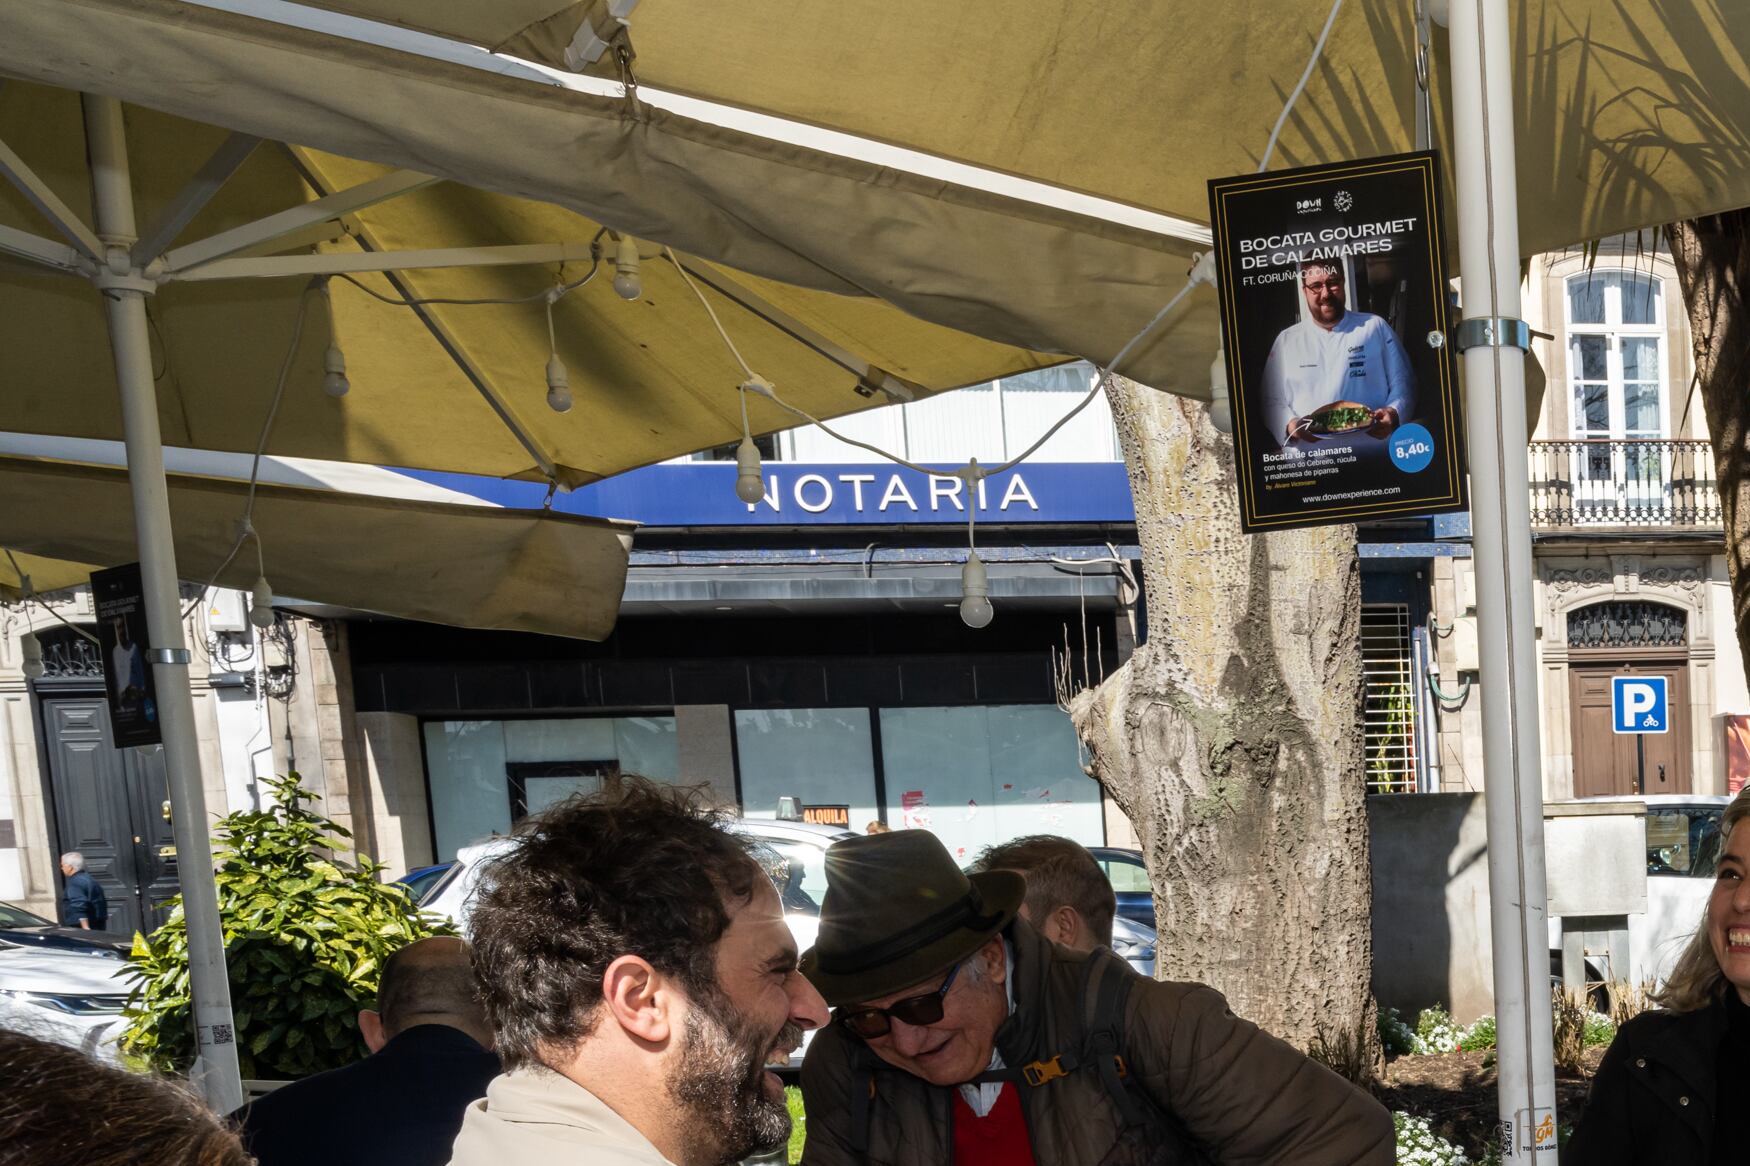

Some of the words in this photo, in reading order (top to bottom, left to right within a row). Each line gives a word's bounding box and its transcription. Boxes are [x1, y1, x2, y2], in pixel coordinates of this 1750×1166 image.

[1240, 232, 1315, 253] BOCATA
[1319, 218, 1416, 242] GOURMET
[1242, 255, 1268, 270] DE
[1272, 238, 1392, 266] CALAMARES
[1243, 275, 1256, 286] FT.
[1258, 269, 1298, 285] CORUÑA
[1263, 452, 1293, 462] Bocata
[1294, 449, 1306, 459] de
[1307, 446, 1353, 458] calamares
[1396, 442, 1430, 459] 8,40€
[1264, 464, 1276, 472] con
[1276, 461, 1296, 472] queso
[1264, 474, 1269, 482] y
[1270, 470, 1303, 480] mahonesa
[1304, 468, 1312, 476] de
[747, 473, 1039, 513] NOTARIA
[1302, 486, 1401, 503] www.downexperience.com
[1624, 684, 1656, 727] P
[804, 808, 848, 825] ALQUILA
